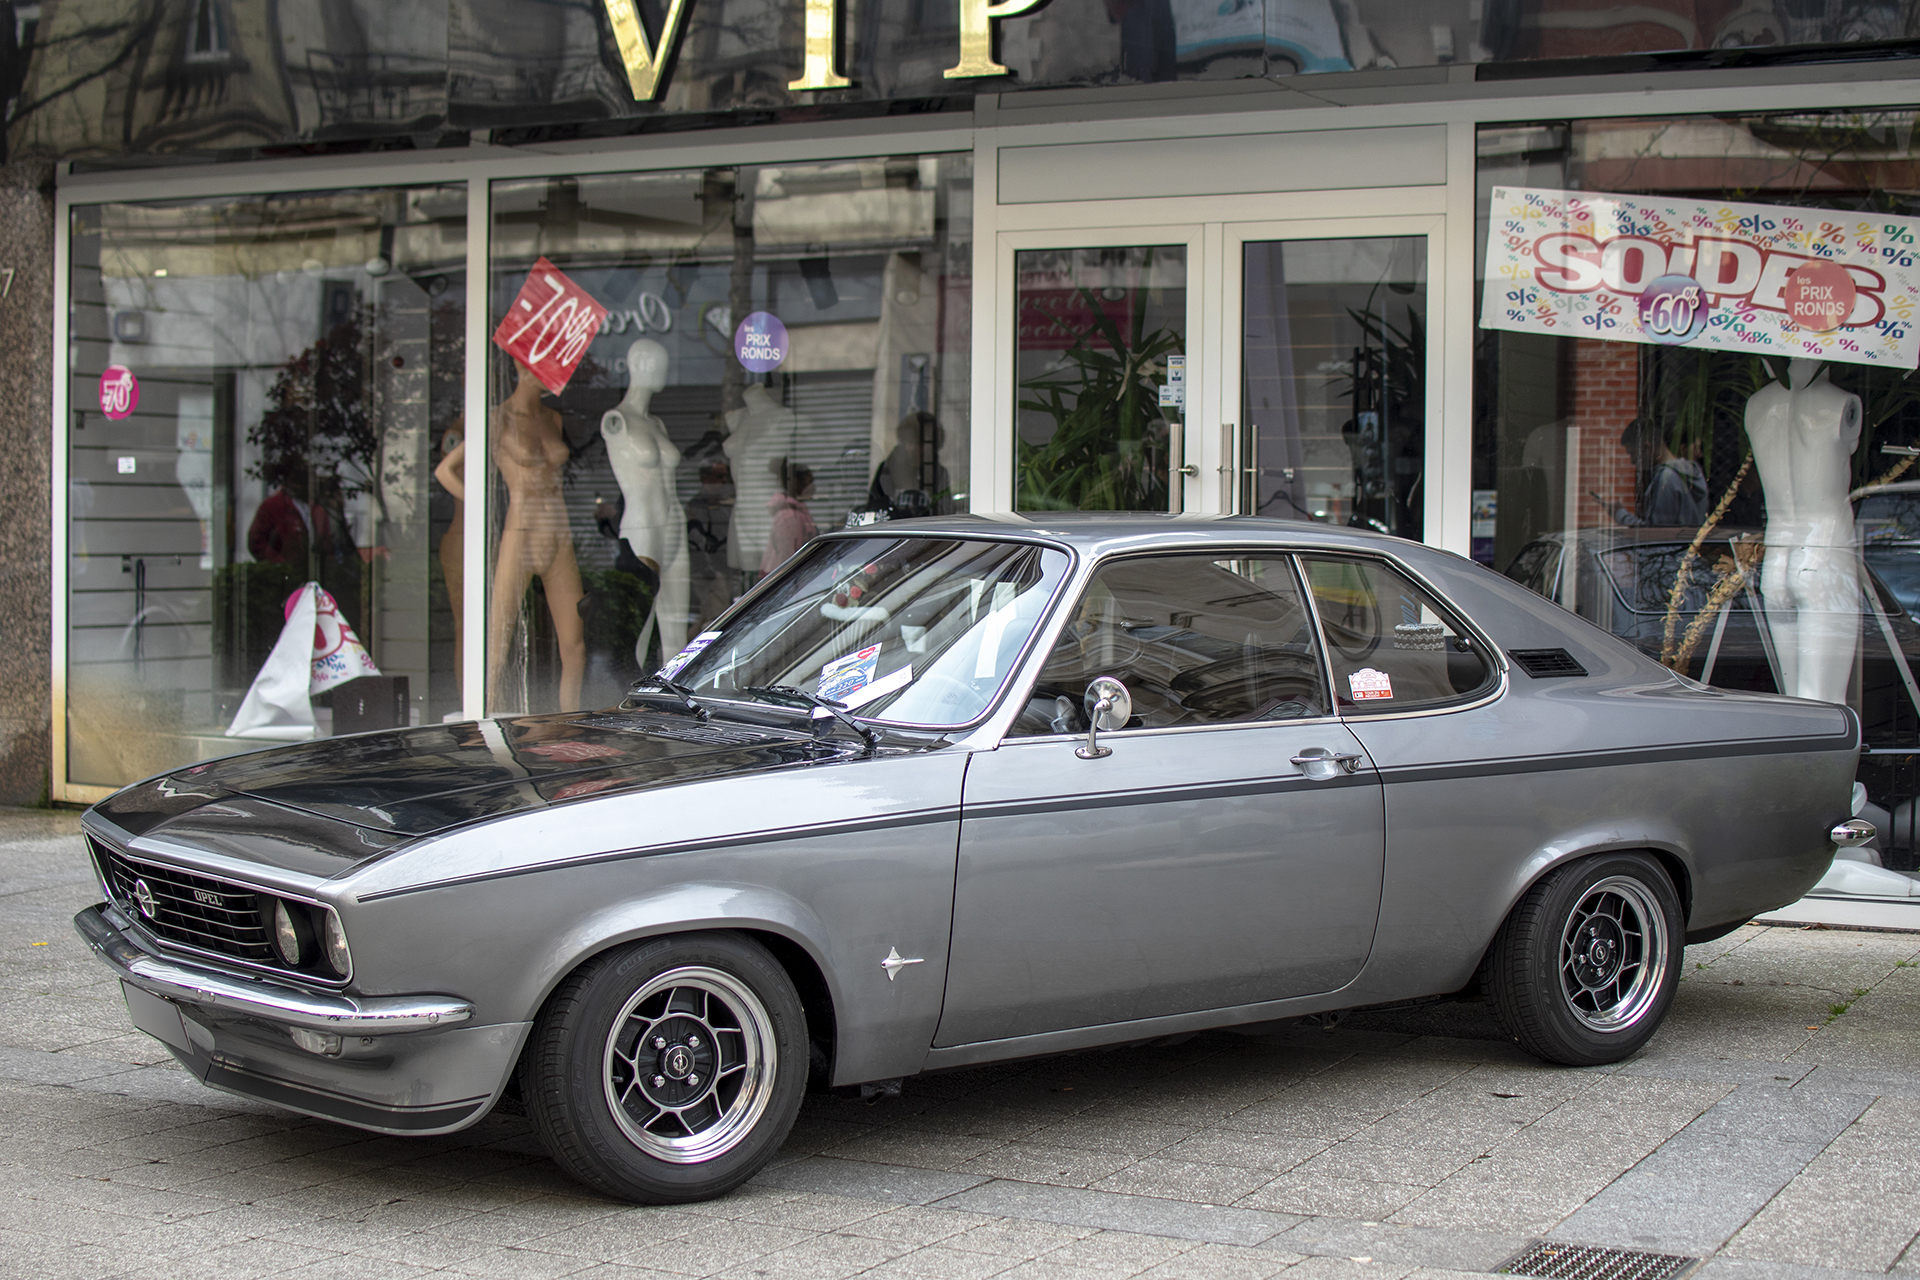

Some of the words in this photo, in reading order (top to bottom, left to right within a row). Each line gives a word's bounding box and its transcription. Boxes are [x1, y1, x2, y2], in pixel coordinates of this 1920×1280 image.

[1796, 275, 1811, 285] les
[1800, 286, 1834, 301] PRIX
[1643, 286, 1703, 336] -60%
[1794, 301, 1845, 317] RONDS
[508, 274, 596, 367] -70%
[746, 333, 771, 347] PRIX
[741, 346, 781, 361] RONDS
[193, 889, 223, 906] OPEL
